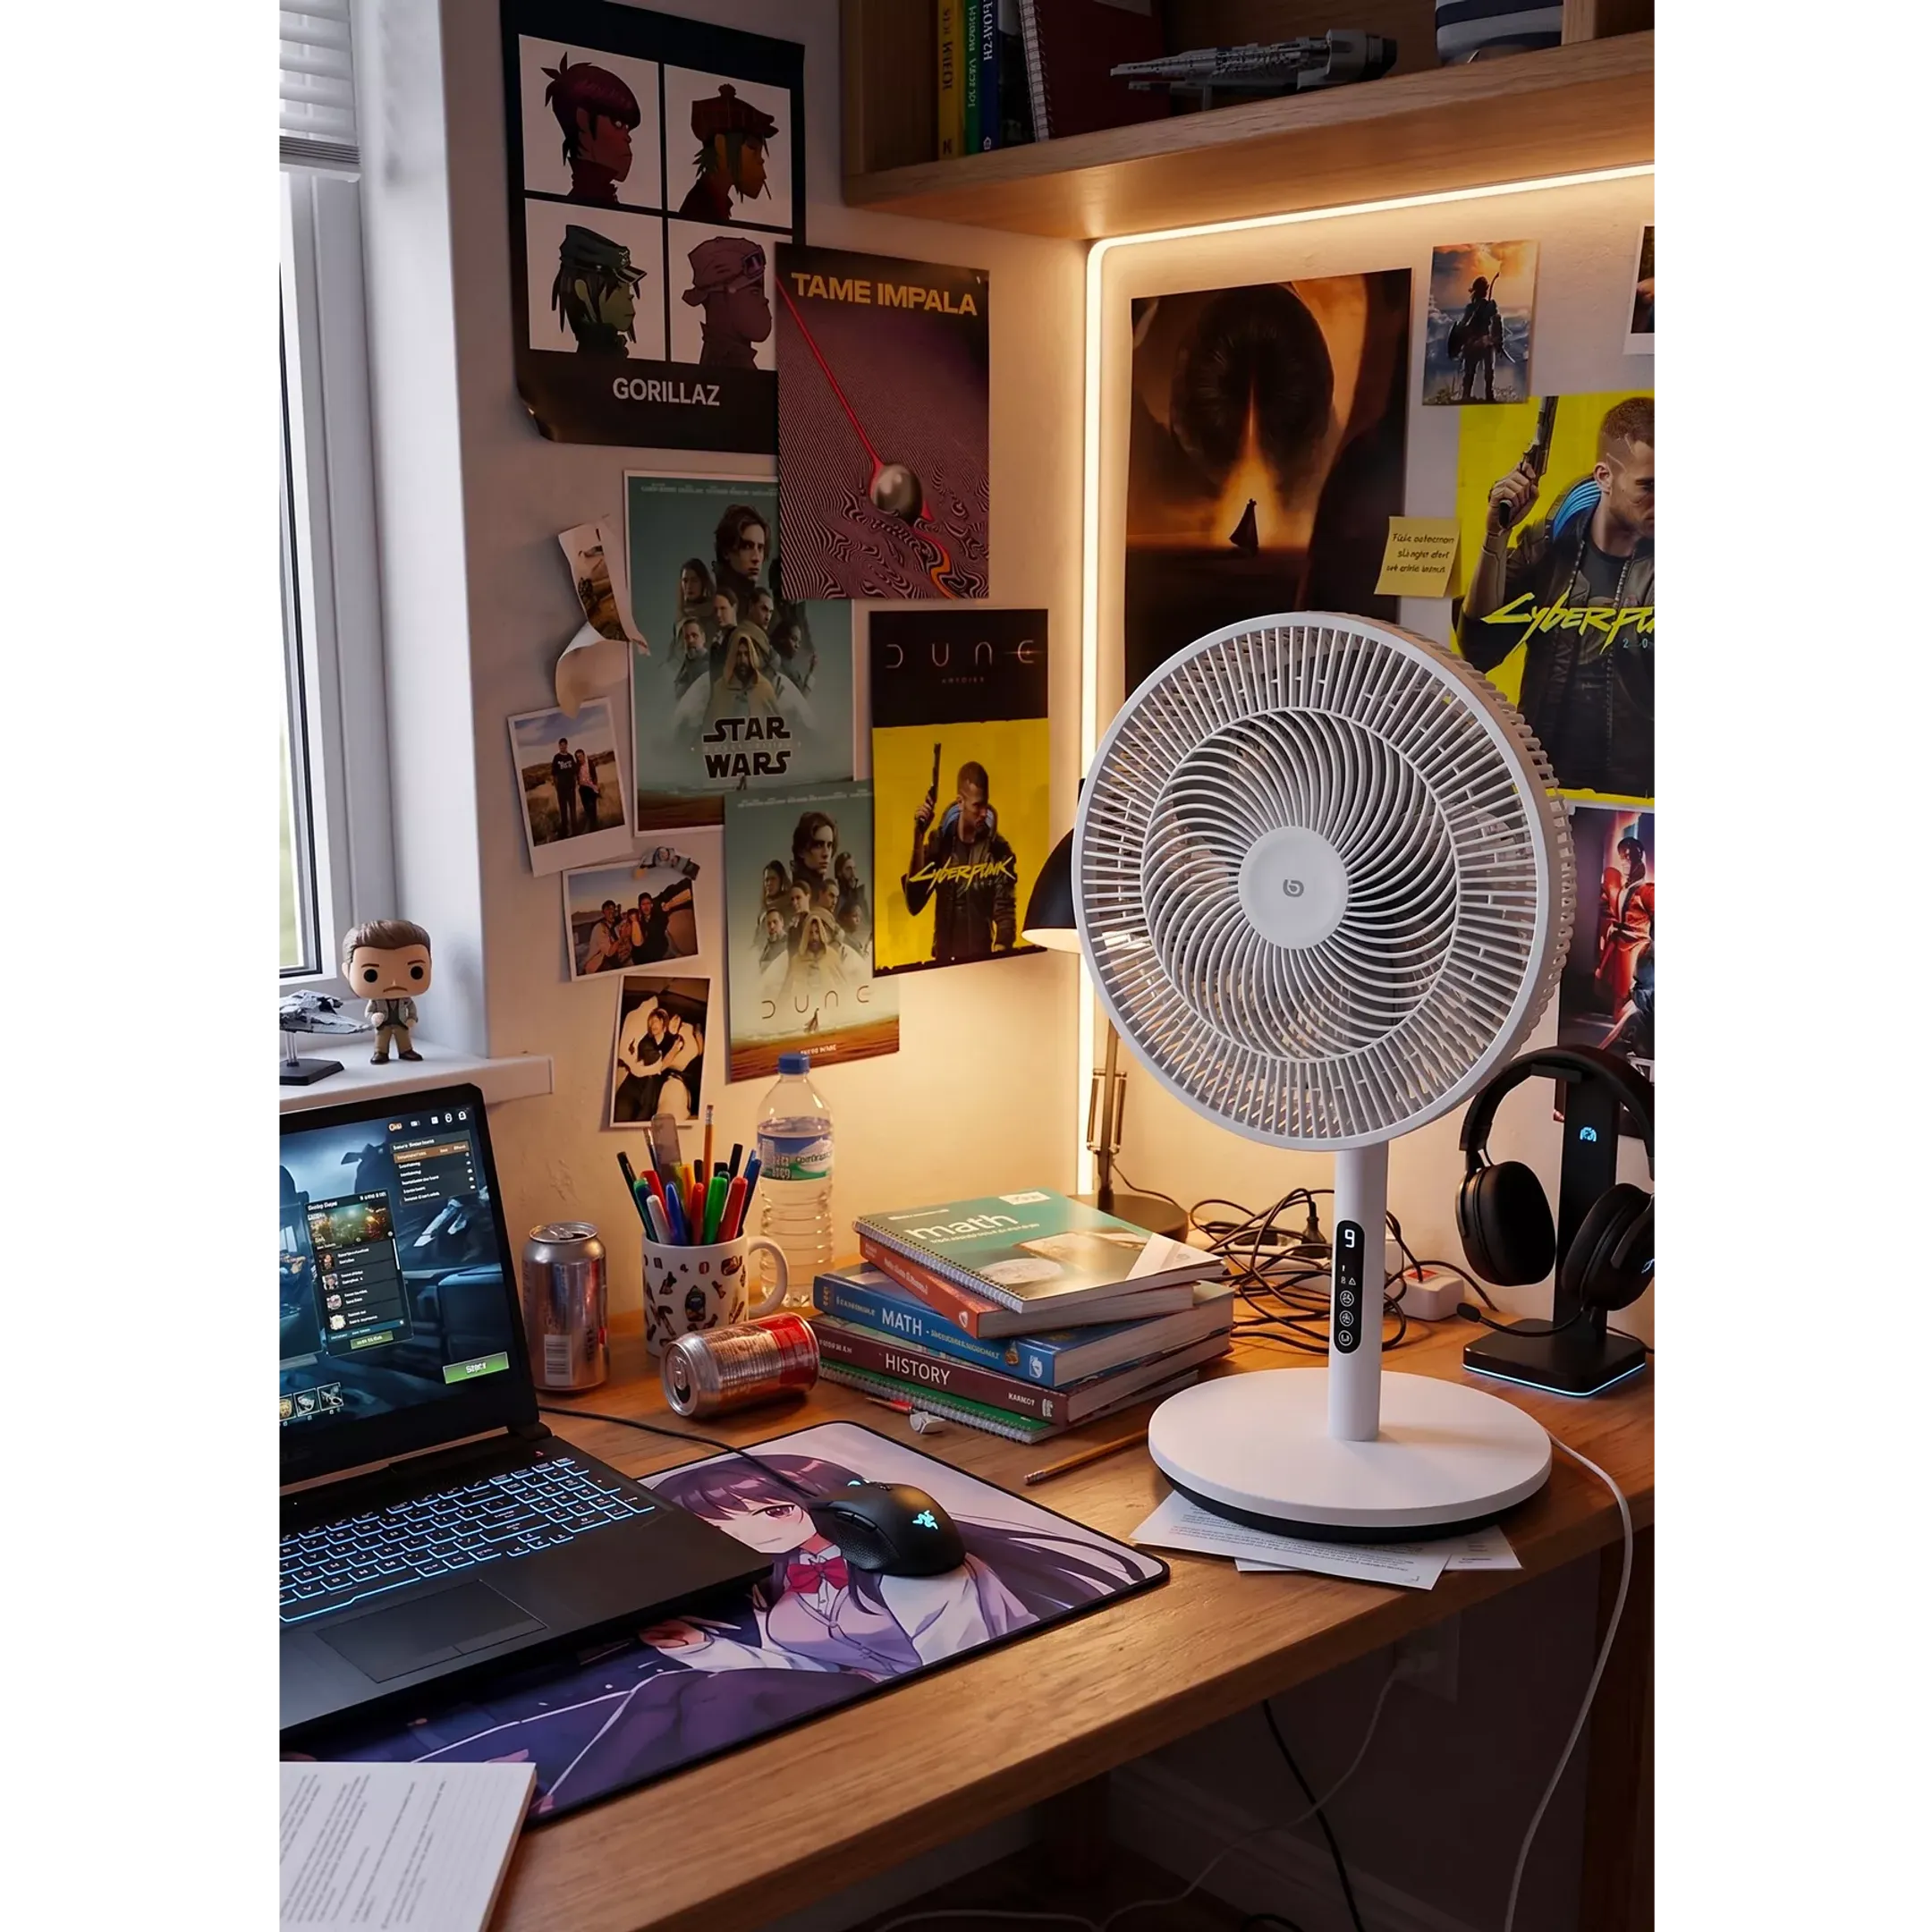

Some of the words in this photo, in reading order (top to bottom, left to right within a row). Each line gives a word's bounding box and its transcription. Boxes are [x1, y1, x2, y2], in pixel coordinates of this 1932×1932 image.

[792, 272, 872, 305] TAME
[877, 283, 978, 317] IMPALA
[612, 377, 721, 406] GORILLAZ
[702, 716, 792, 742] STAR
[704, 750, 792, 779] WARS
[903, 1214, 1019, 1240] math
[1344, 1228, 1356, 1249] 9
[881, 1307, 922, 1336] MATH
[885, 1352, 951, 1385] HISTORY
